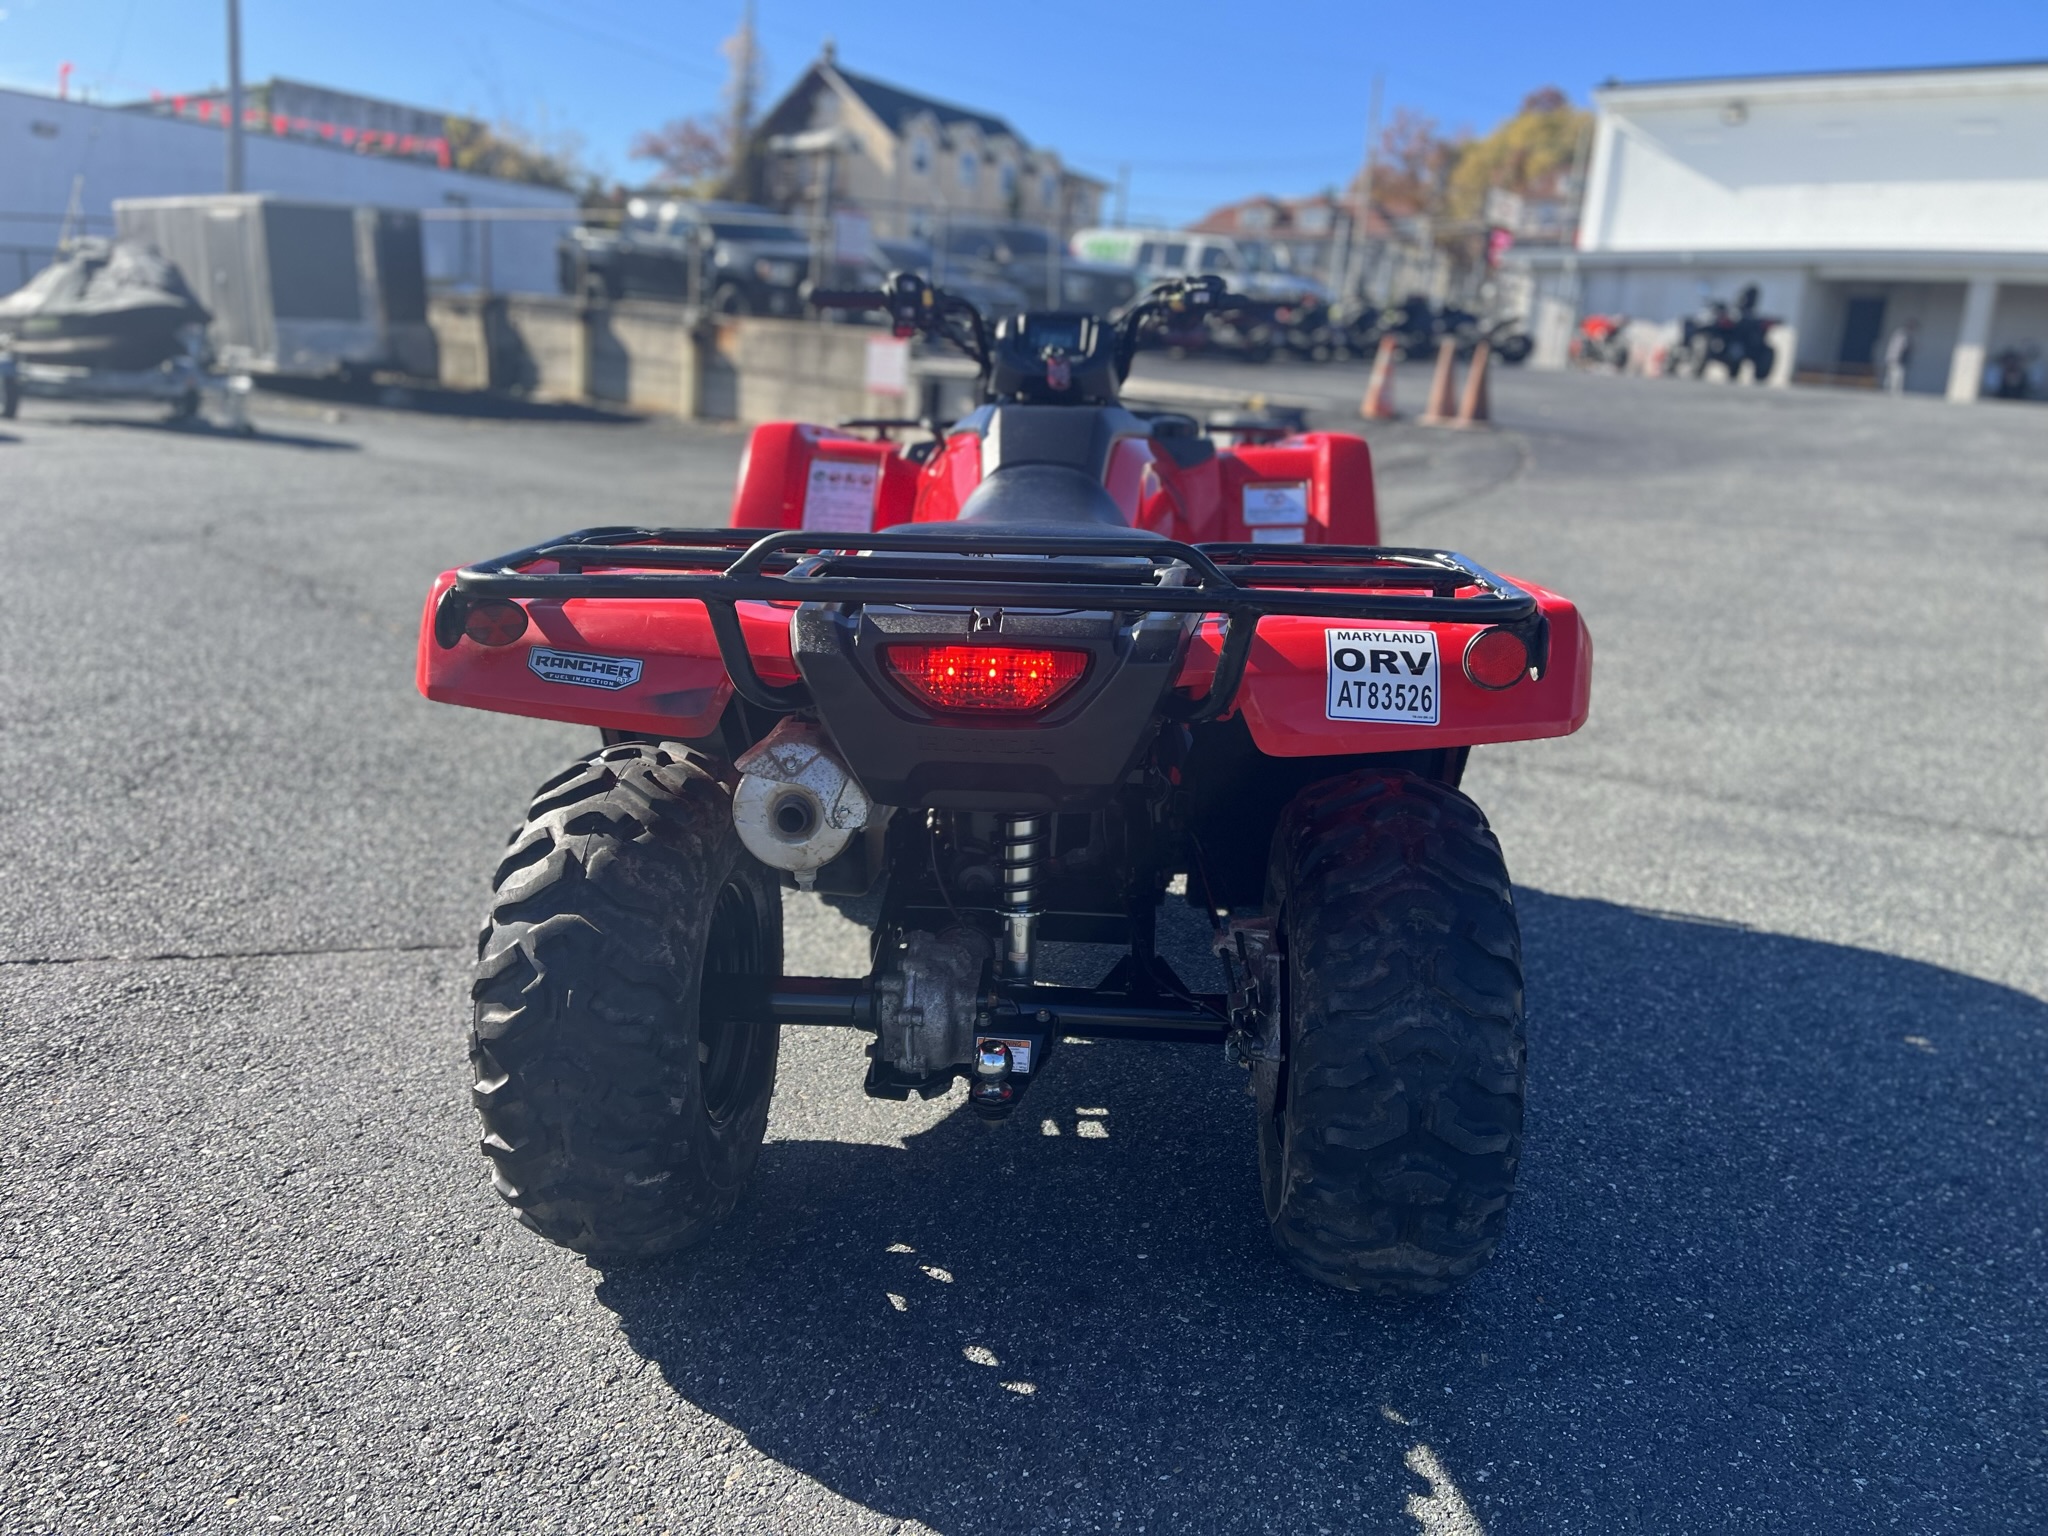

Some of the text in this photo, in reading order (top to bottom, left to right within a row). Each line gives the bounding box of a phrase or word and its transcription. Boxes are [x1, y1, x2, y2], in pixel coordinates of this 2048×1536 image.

[1337, 631, 1425, 644] MARYLAND
[535, 656, 634, 678] RANCHER
[1333, 647, 1432, 676] ORV
[572, 676, 614, 686] INJECTION
[1337, 680, 1432, 713] AT83526
